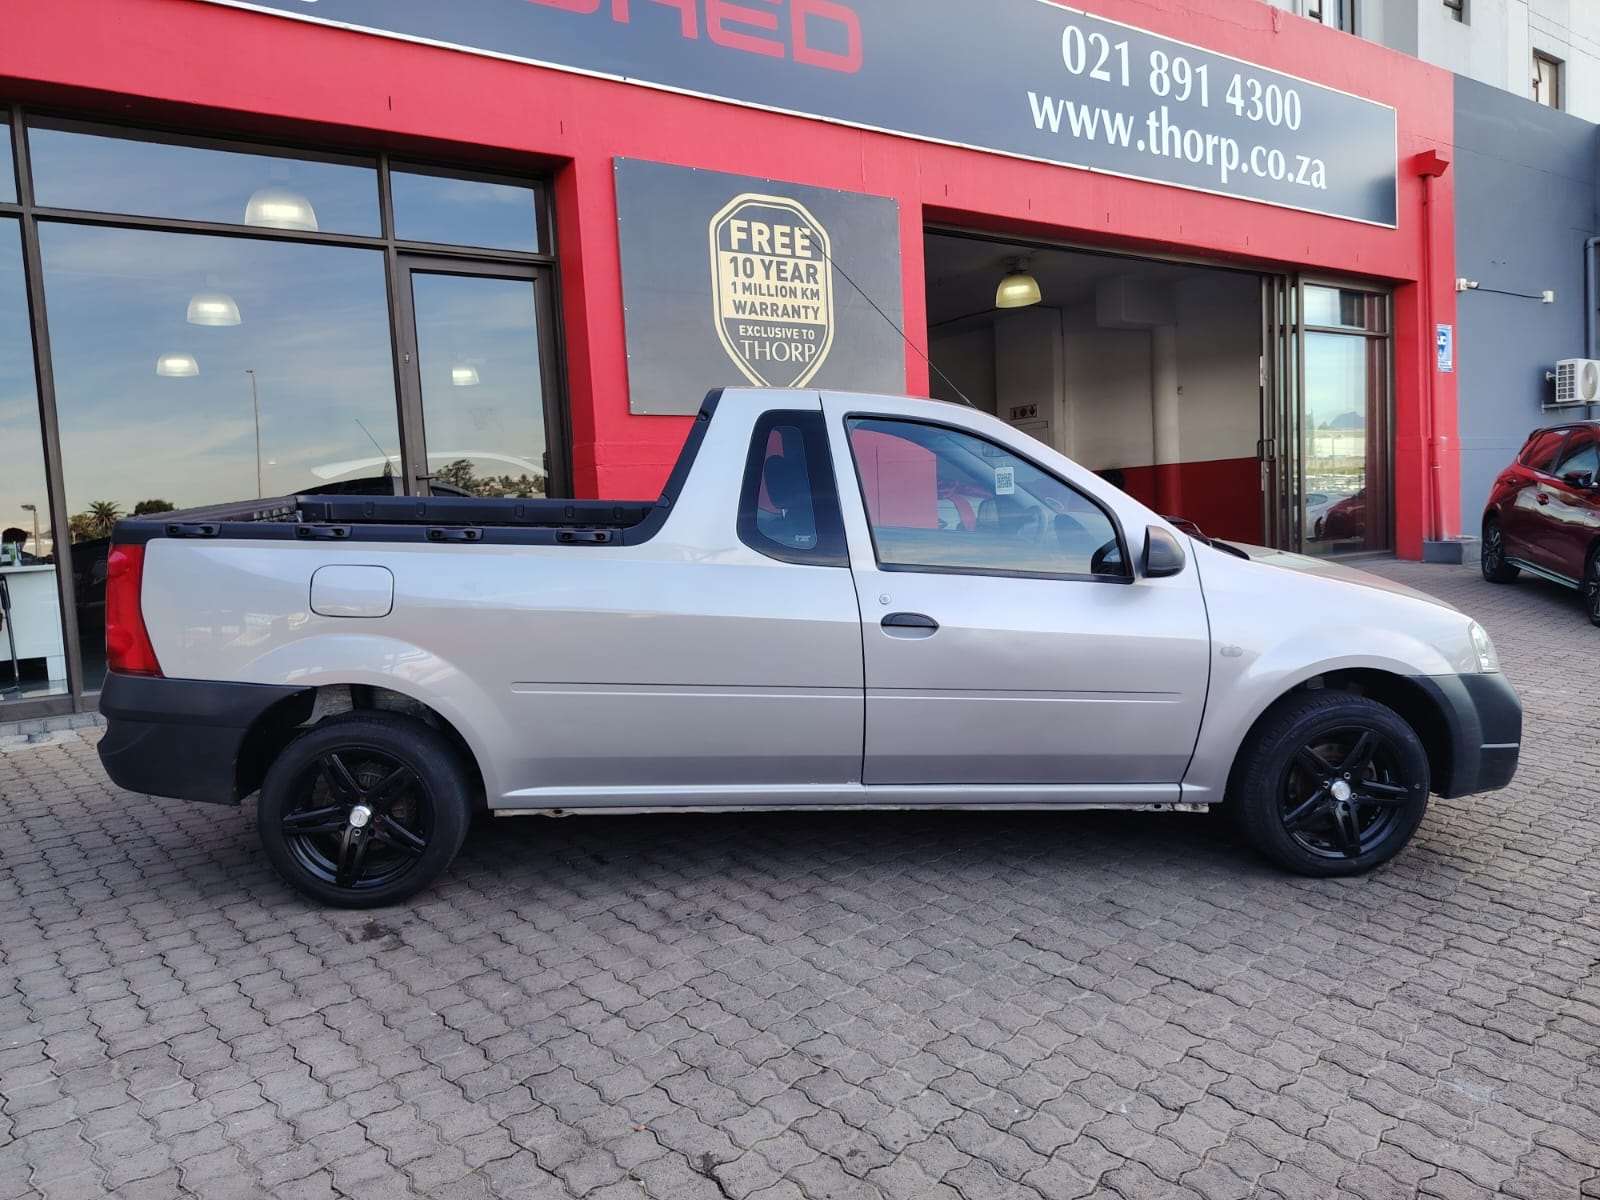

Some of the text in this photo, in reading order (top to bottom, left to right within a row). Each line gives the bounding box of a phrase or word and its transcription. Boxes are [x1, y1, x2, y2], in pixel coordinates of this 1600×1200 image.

[1062, 25, 1302, 131] 021 891 4300
[1027, 91, 1328, 190] www.thorp.co.za
[730, 219, 812, 257] FREE
[730, 256, 819, 285] 10 YEAR
[731, 281, 820, 301] 1 MILLION KM
[732, 299, 820, 321] WARRANTY
[739, 325, 815, 340] EXCLUSIVE TO
[740, 340, 816, 363] THORP
